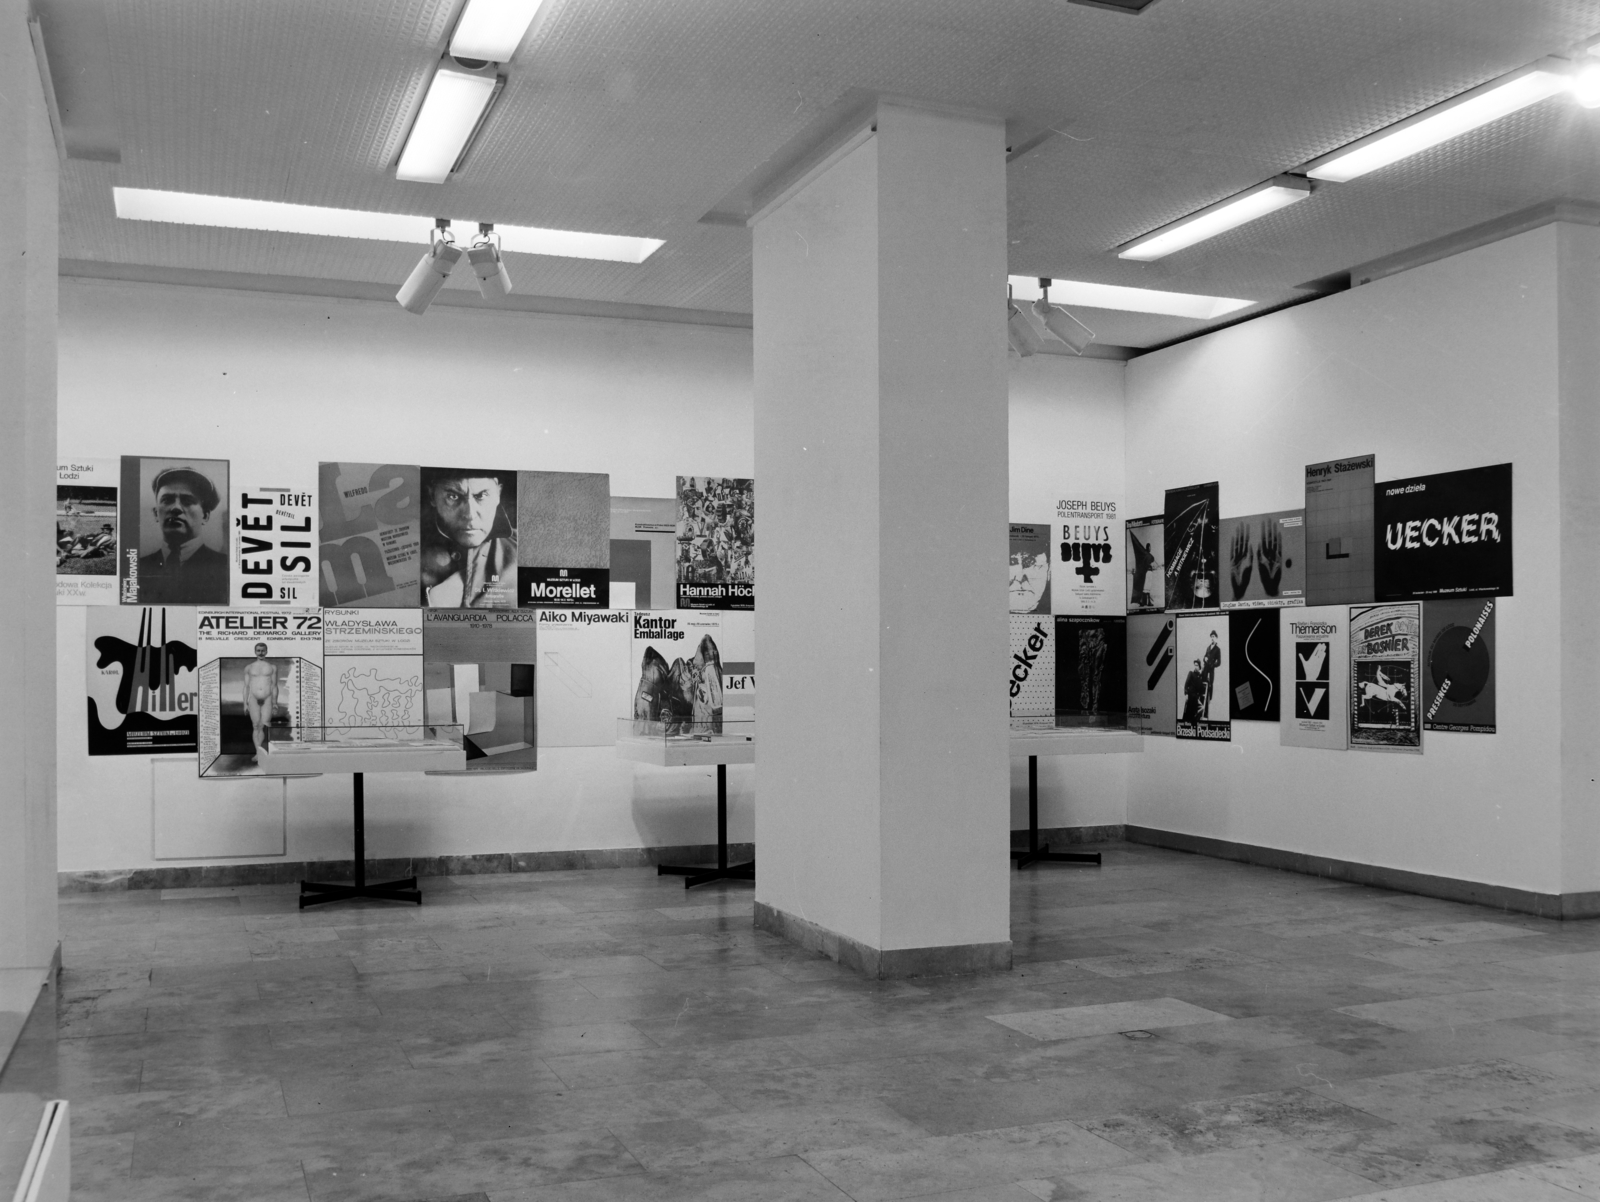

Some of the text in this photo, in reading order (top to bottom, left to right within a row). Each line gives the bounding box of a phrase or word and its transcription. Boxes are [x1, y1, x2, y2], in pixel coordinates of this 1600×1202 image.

[70, 464, 94, 472] Sztuki
[1306, 458, 1373, 478] Henryk Stażewski
[344, 486, 368, 498] WILFREDO
[1386, 483, 1426, 496] nowe dzieła
[280, 492, 312, 507] DEVĚT
[1056, 500, 1116, 512] JOSEPH BEUYS
[1058, 512, 1104, 520] POLENTRANSPORT
[1063, 524, 1109, 542] BEUYS
[1386, 511, 1500, 550] UECKER
[236, 493, 274, 599] DEVĚT
[280, 516, 312, 573] SIL
[126, 548, 140, 603] Majakowski
[81, 581, 112, 590] Kolekcja
[531, 582, 596, 598] Morellet
[680, 584, 726, 596] Hannah
[280, 587, 298, 600] SIL
[198, 616, 322, 629] ATELIER 72
[427, 614, 533, 622] L'AVANGUARDIA POLACCA
[540, 611, 629, 626] Aiko Miyawaki
[634, 616, 677, 629] Kantor
[1465, 601, 1494, 649] POLONAISES
[325, 626, 422, 634] STRZEMIŃSKIEGO
[634, 629, 685, 641] Emballage
[1290, 622, 1337, 634] Themerson
[1364, 622, 1393, 640] DEREK
[1366, 635, 1410, 655] BOSHIER
[1010, 622, 1048, 717] ecker
[726, 676, 746, 690] Jef
[1426, 678, 1452, 720] PRESENCES
[1177, 725, 1196, 737] Brzeski
[1197, 726, 1230, 739] Podsadecki
